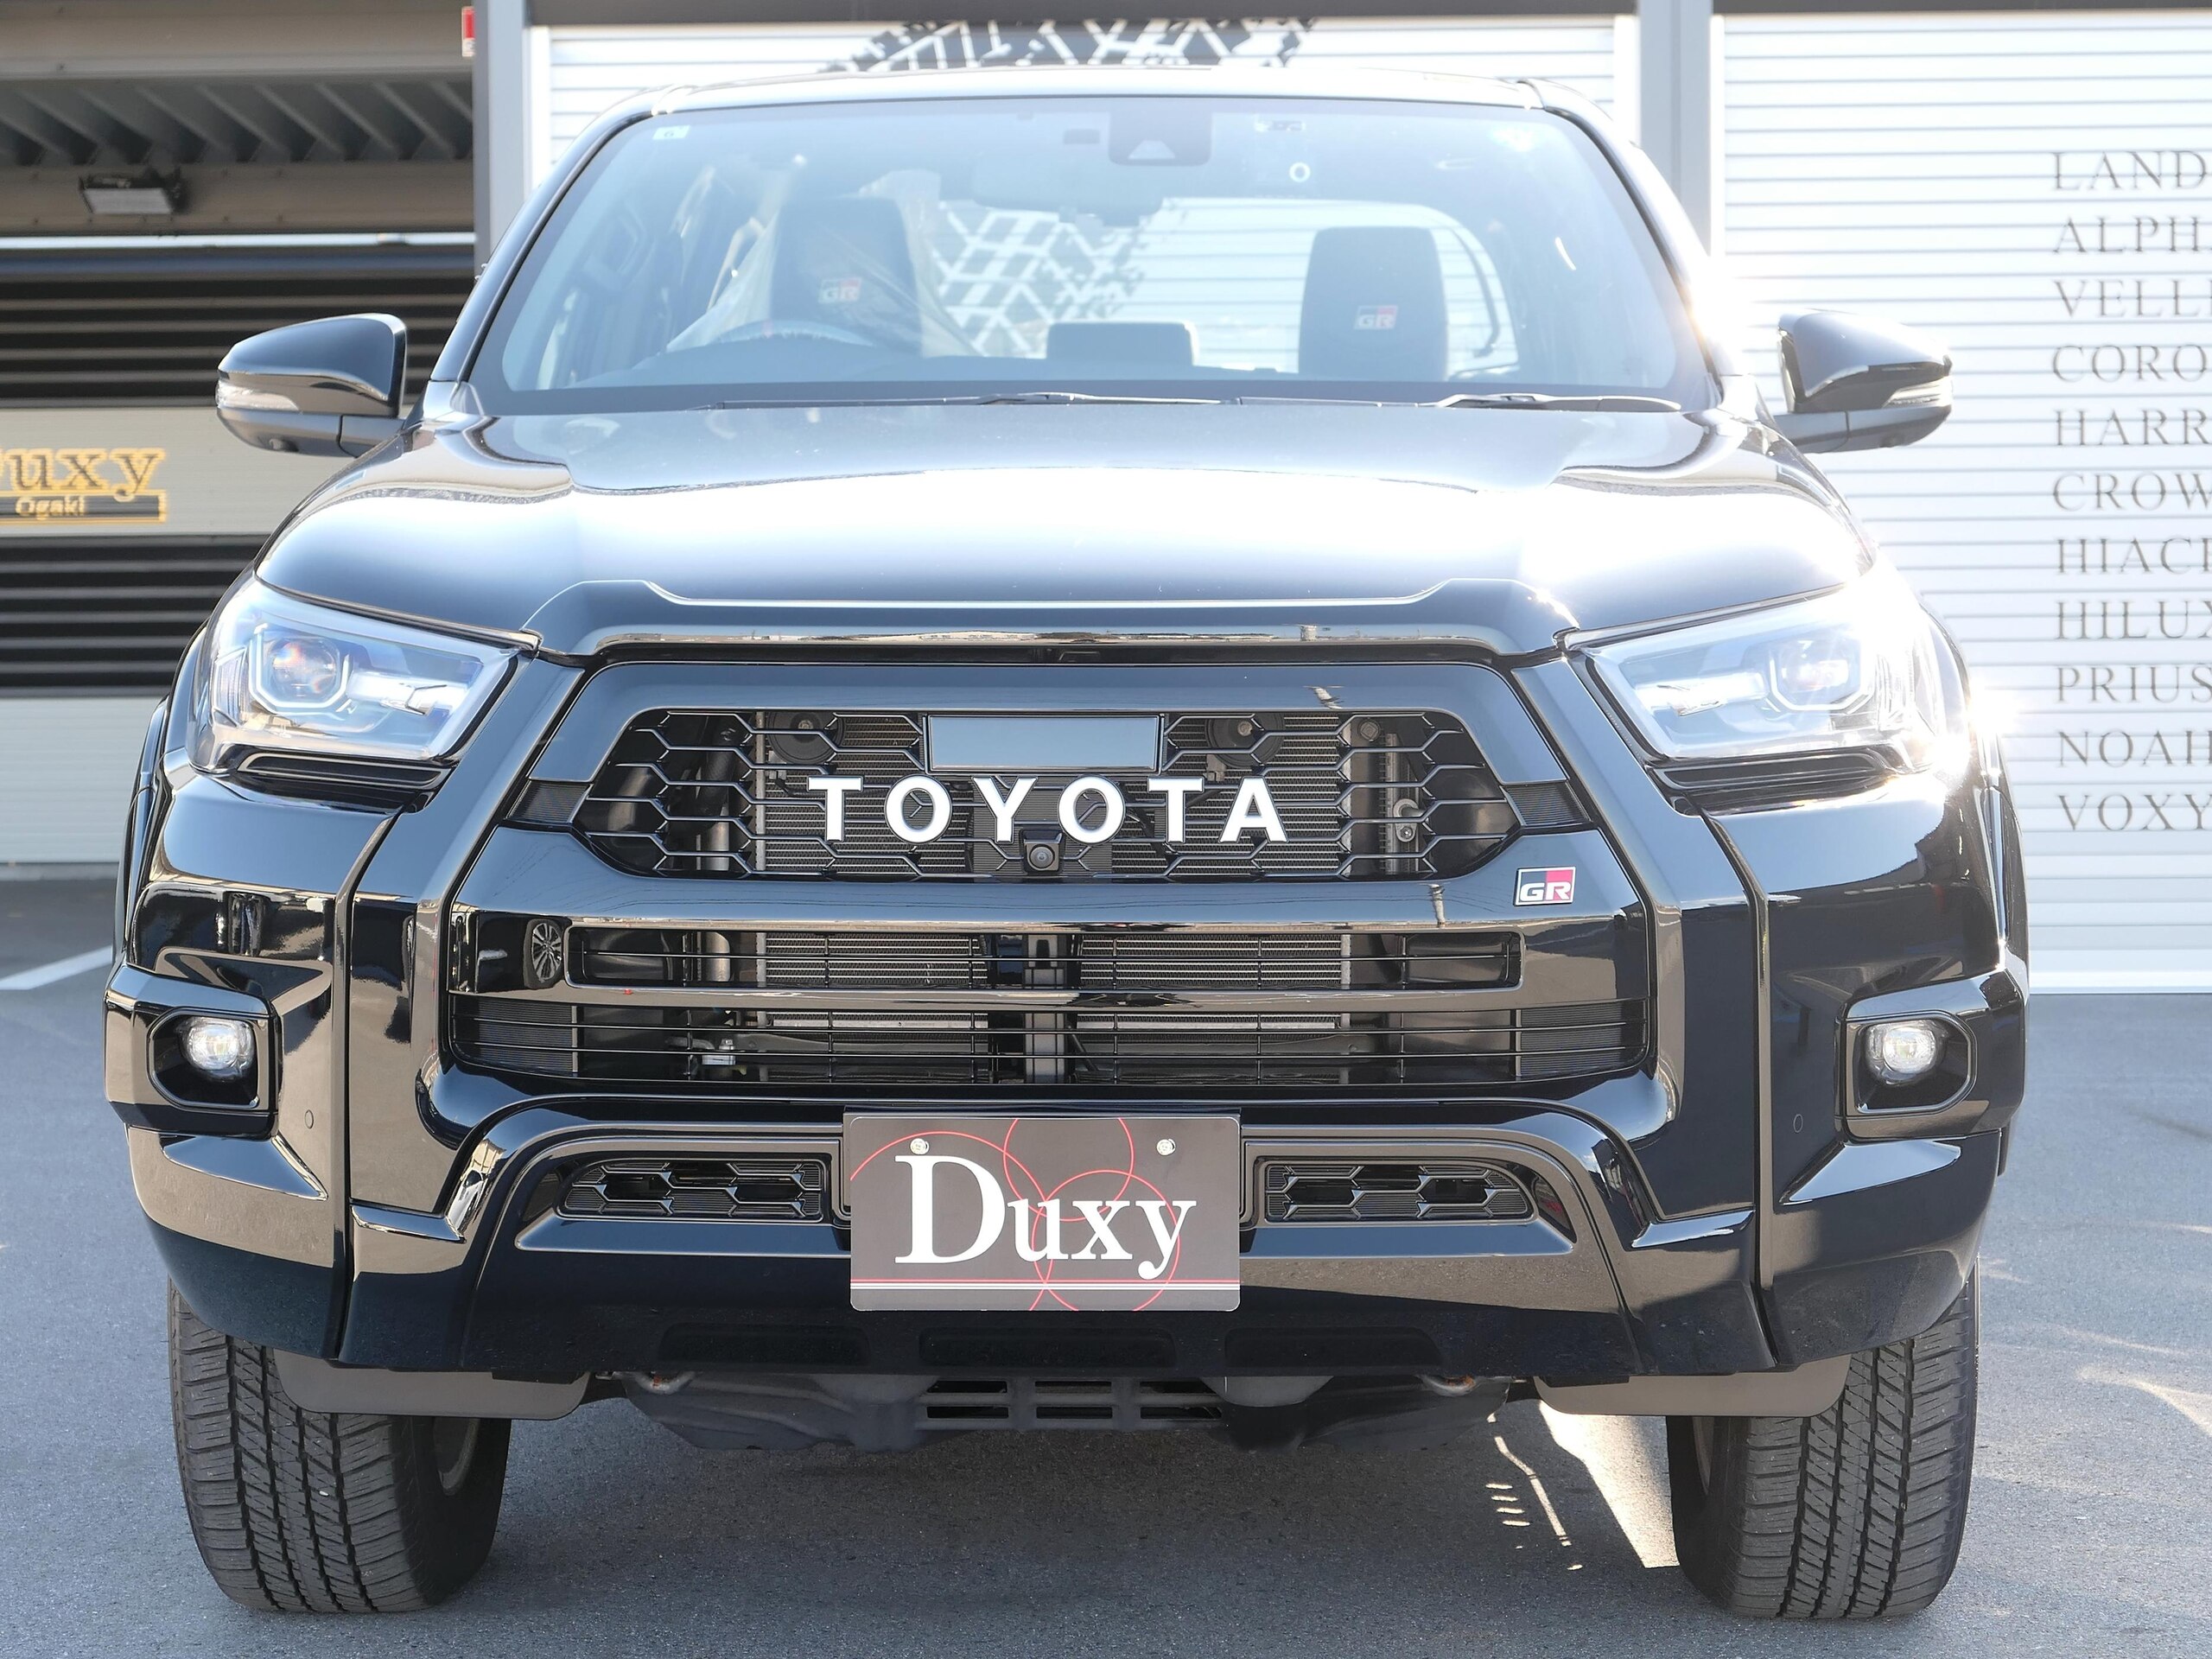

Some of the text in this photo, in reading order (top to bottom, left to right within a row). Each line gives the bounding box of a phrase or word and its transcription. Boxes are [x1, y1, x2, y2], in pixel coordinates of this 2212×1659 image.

[2053, 149, 2208, 190] LAND
[2053, 216, 2212, 253] ALPH
[2054, 278, 2212, 318] VELL
[1357, 313, 1396, 328] GR
[2052, 345, 2208, 383] CORO
[2054, 409, 2212, 445] HARR
[0, 448, 166, 502] uxy
[16, 496, 85, 520] Ogaki
[2056, 664, 2212, 703] PRIUS
[2057, 730, 2212, 767] NOAH
[808, 775, 1288, 843] TOYOTA
[2059, 793, 2212, 831] VOXY
[1519, 881, 1572, 902] GR
[894, 1154, 1198, 1280] Duxy
